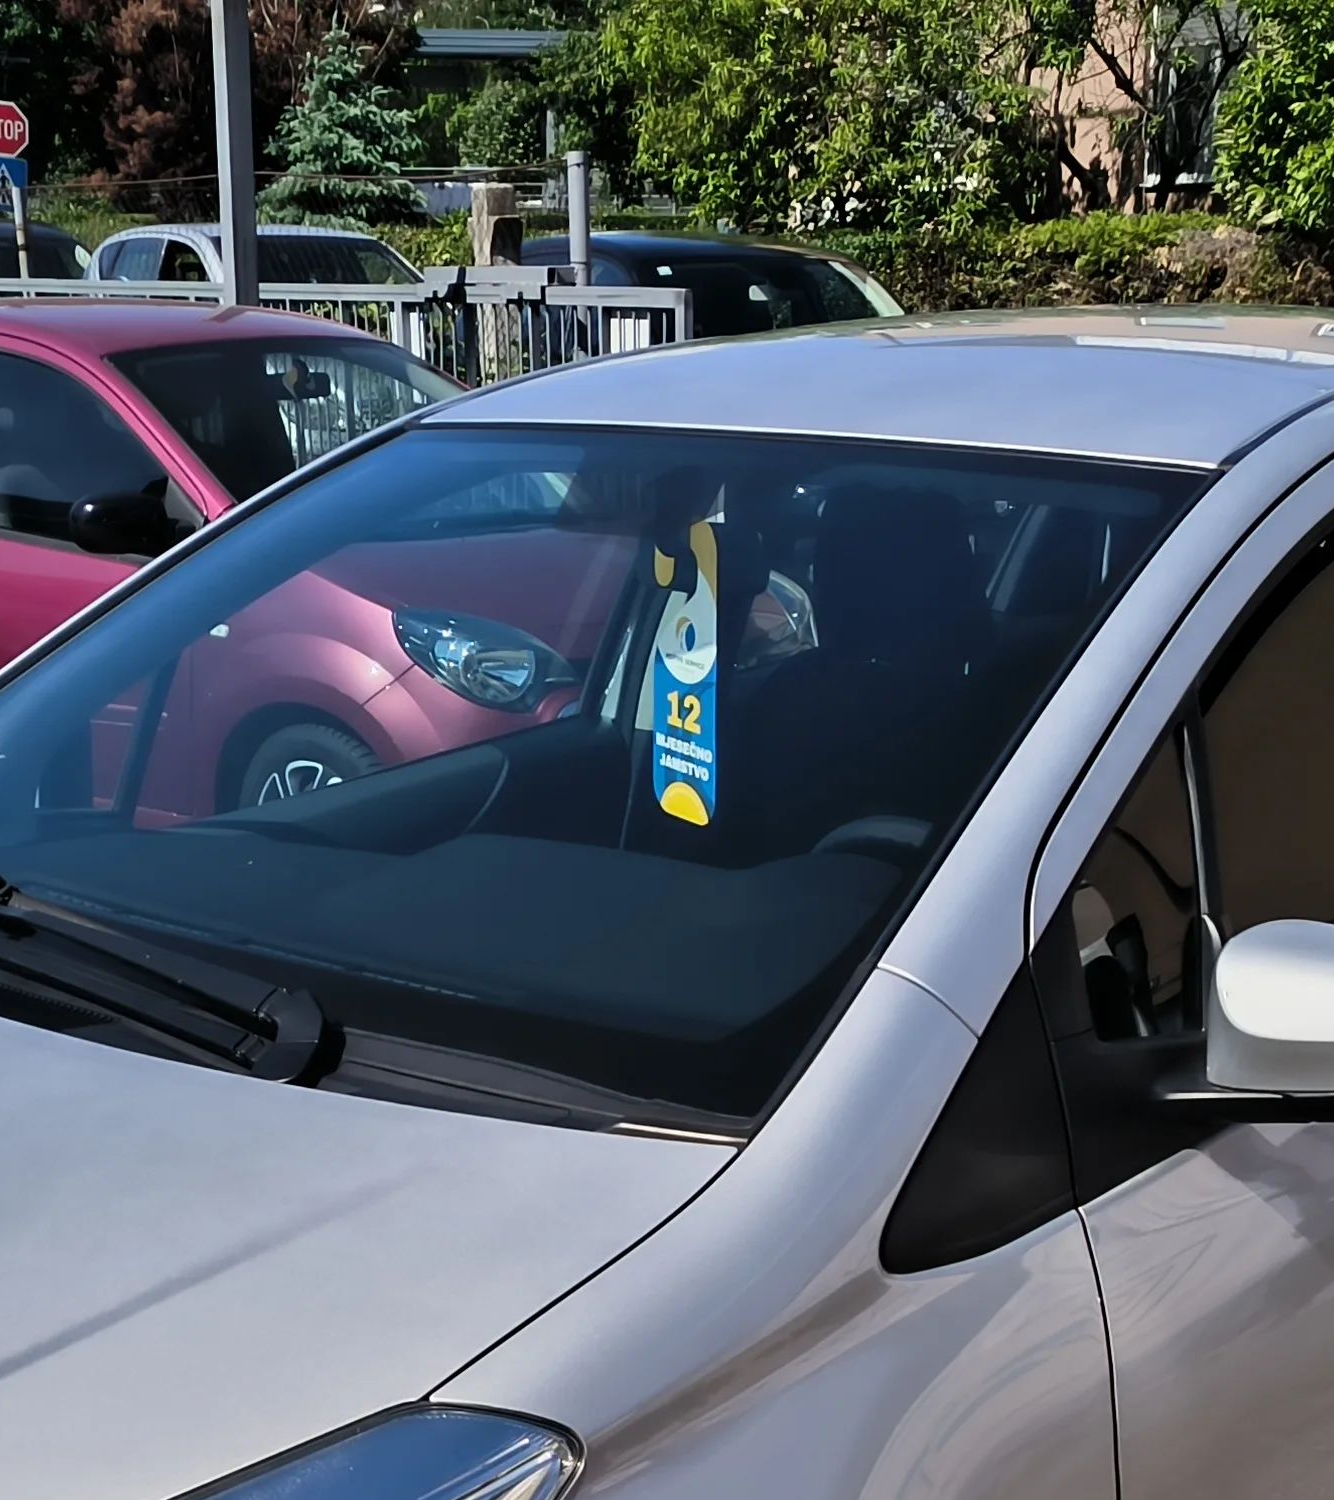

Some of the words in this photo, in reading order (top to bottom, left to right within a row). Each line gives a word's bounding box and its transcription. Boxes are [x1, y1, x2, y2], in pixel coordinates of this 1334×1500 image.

[667, 690, 701, 735] 12
[656, 732, 713, 763] MJESEČNO
[659, 753, 710, 781] JAMSTVO
